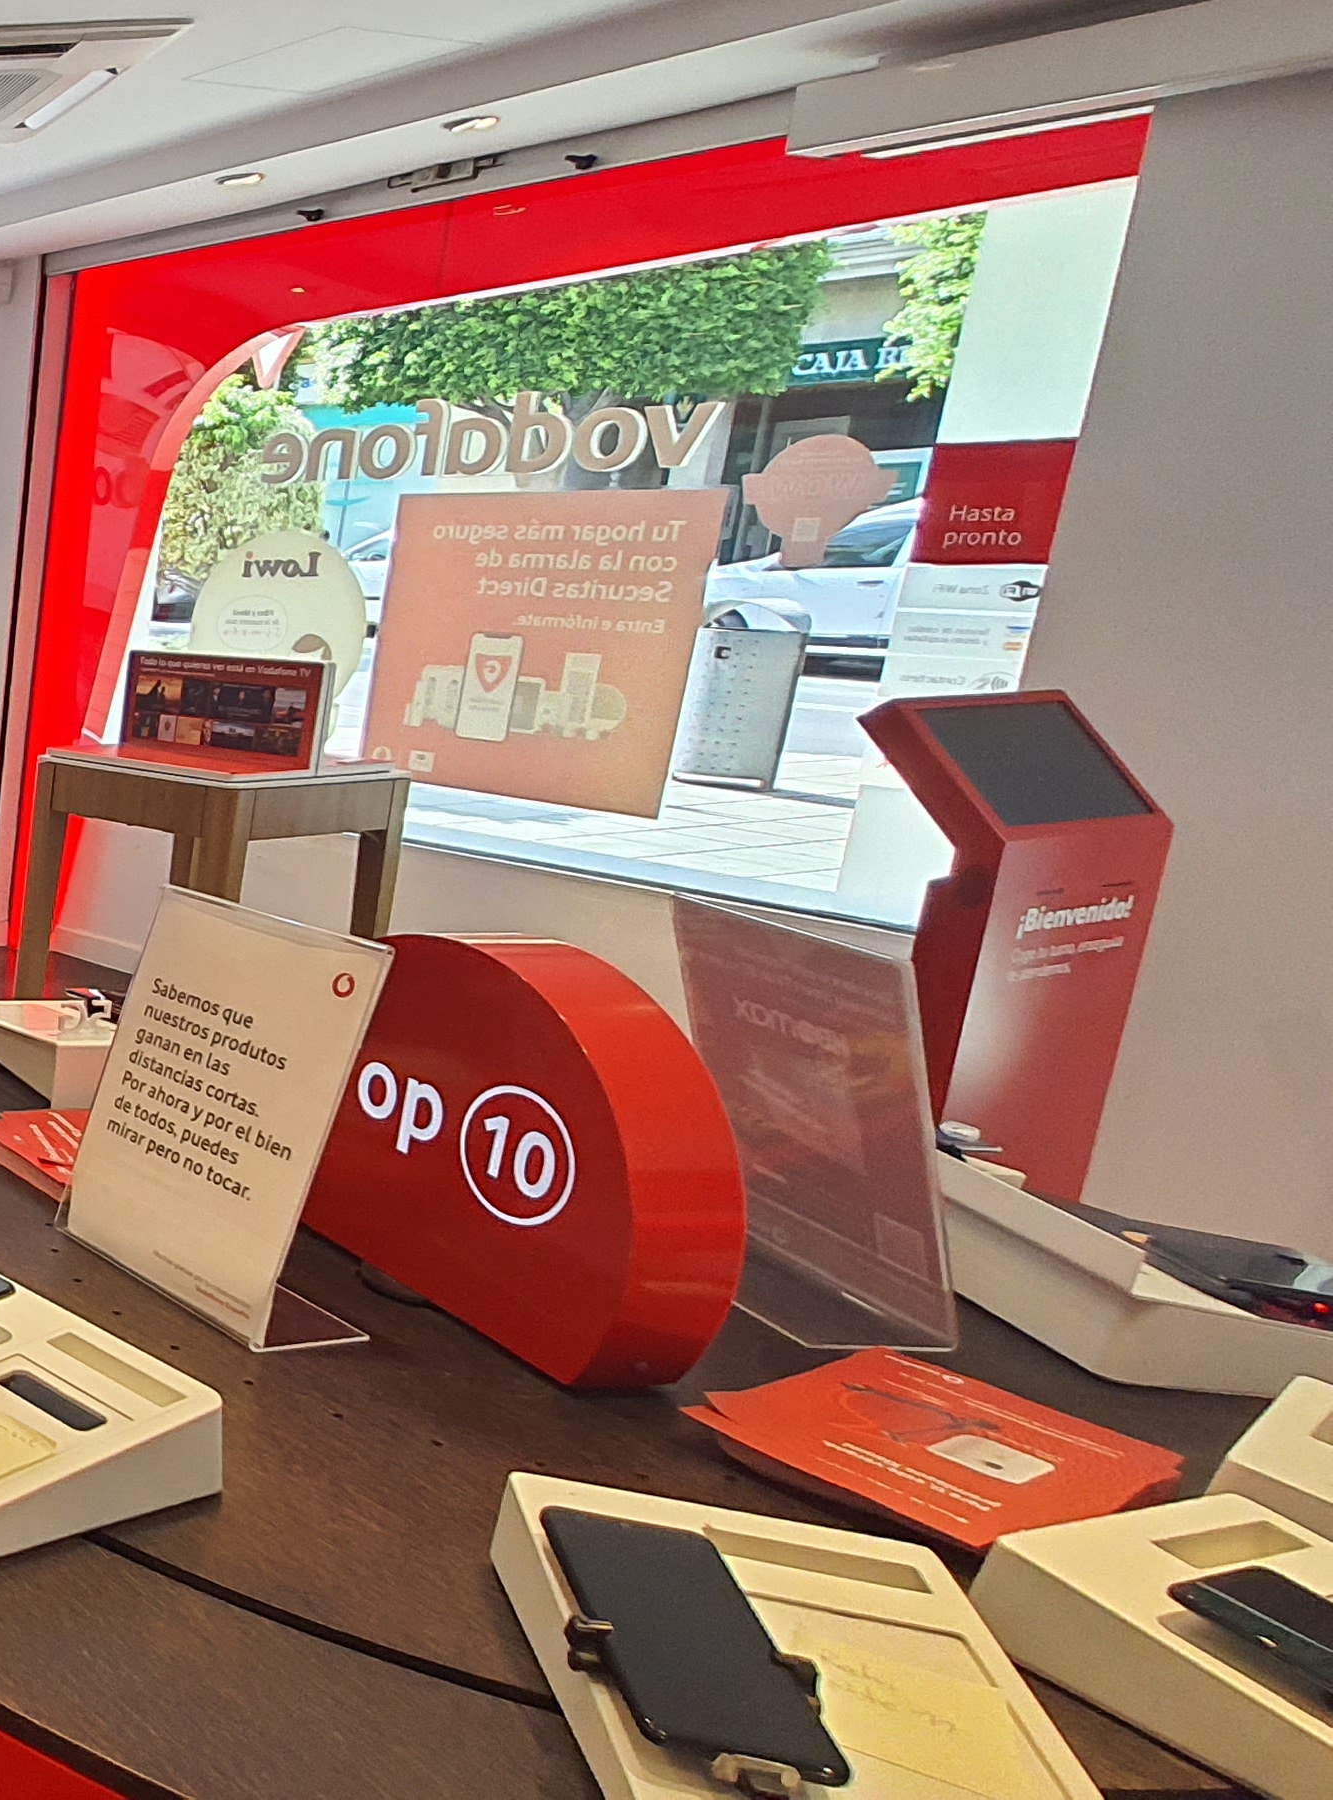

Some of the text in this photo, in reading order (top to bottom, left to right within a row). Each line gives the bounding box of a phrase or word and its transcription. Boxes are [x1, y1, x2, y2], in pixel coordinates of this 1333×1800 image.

[791, 348, 869, 377] CAJA
[942, 528, 1022, 549] pronto
[948, 503, 1016, 523] Hasta
[299, 668, 312, 678] TV
[1015, 894, 1135, 940] ¡Bienvenido!
[151, 977, 254, 1030] Sabemos que
[134, 1027, 231, 1077] ganan en las
[142, 1003, 288, 1071] nuestros produtos
[127, 1049, 260, 1117] distancias cortas.
[113, 1094, 240, 1166] de todos, puedes
[121, 1070, 293, 1161] Por ahora y por el bien
[357, 1060, 556, 1200] op 10
[106, 1118, 145, 1146] mirar
[145, 1136, 181, 1164] pero
[182, 1154, 204, 1176] no
[205, 1162, 251, 1201] tocar.
